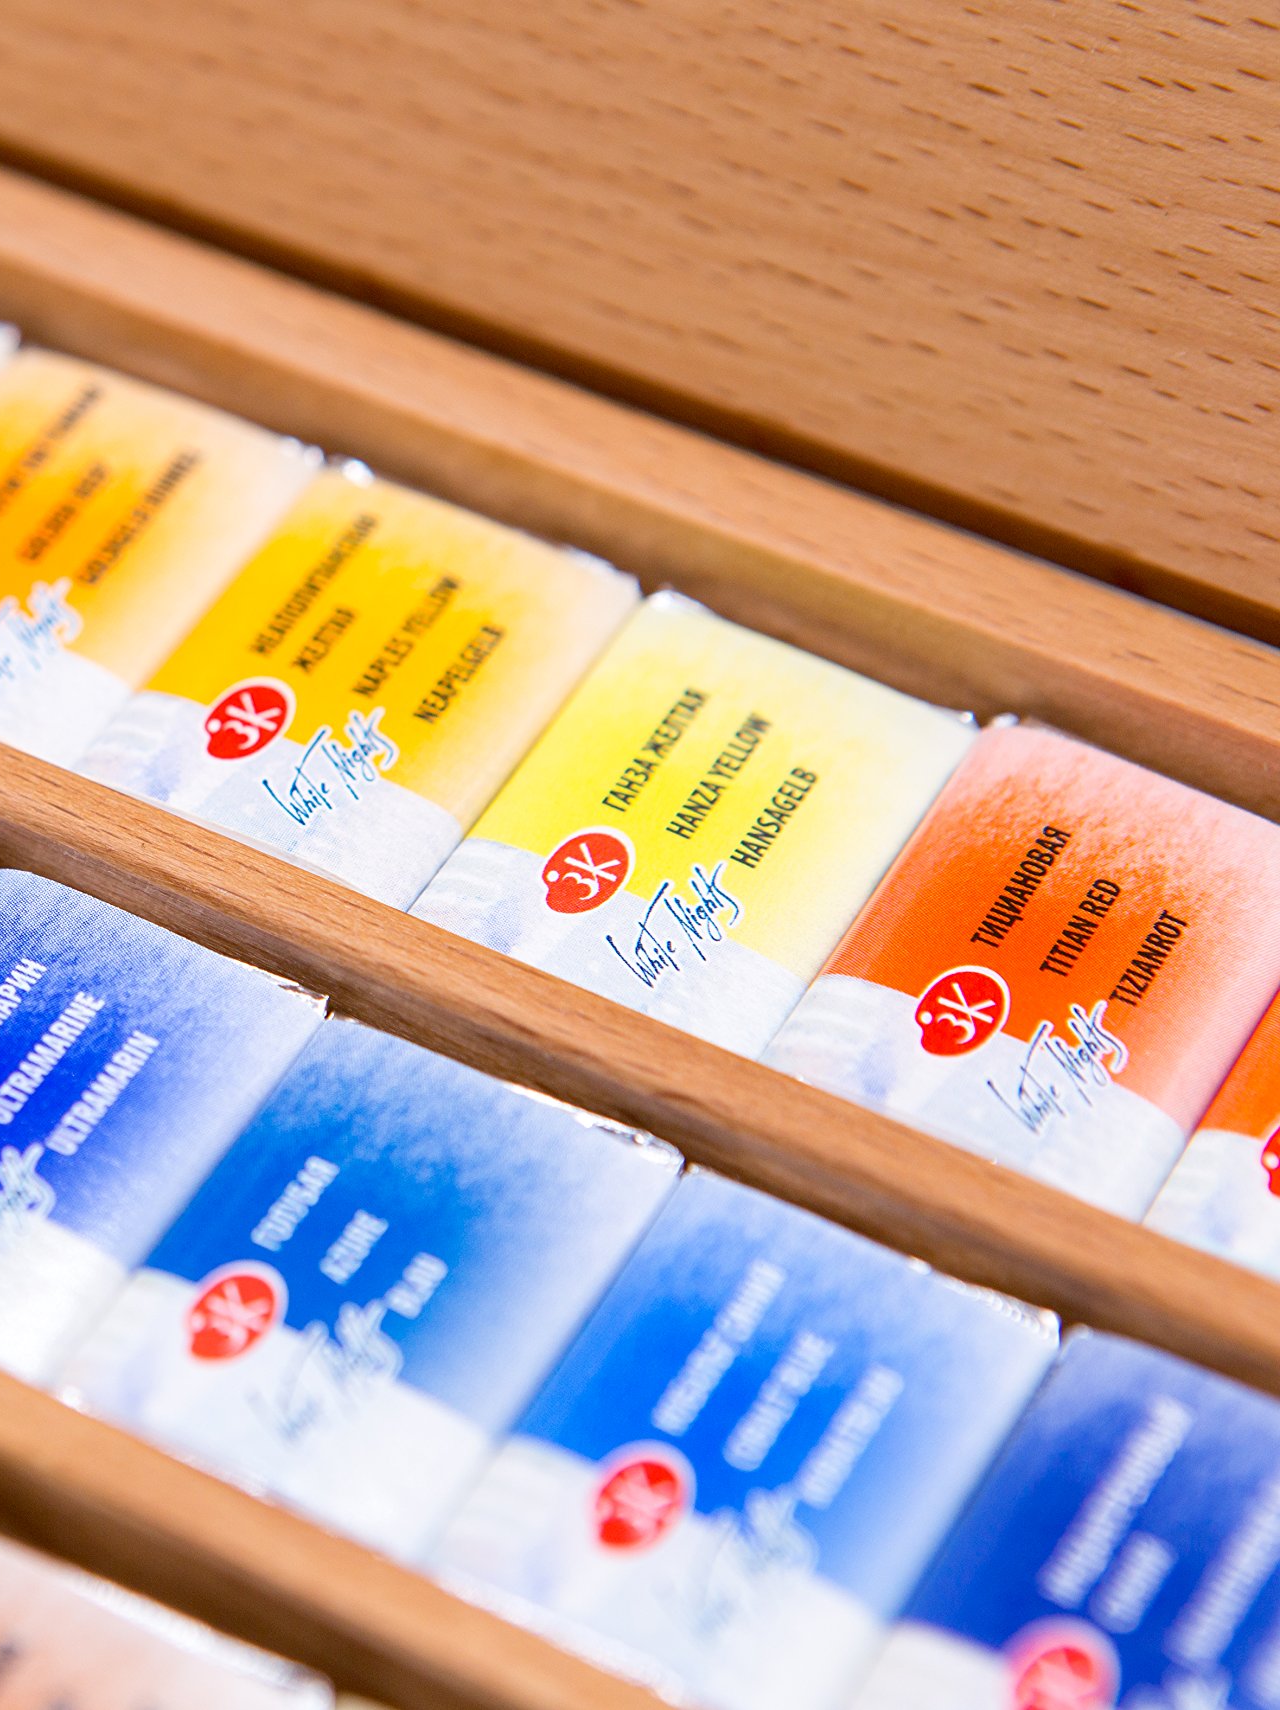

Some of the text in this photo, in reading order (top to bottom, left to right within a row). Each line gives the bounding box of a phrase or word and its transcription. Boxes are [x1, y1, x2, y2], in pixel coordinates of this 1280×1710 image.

[602, 688, 710, 812] ГАНЗА ЖЕЛТАЯ
[666, 715, 769, 839] HANZA YELLOW
[730, 766, 818, 869] HANSAGELB
[971, 825, 1071, 949] ТИЦИАНОВАЯ
[1039, 878, 1122, 978] TITIAN RED
[1109, 909, 1189, 1007] TIZIANROT
[44, 1029, 160, 1156] ULTRAMARIN
